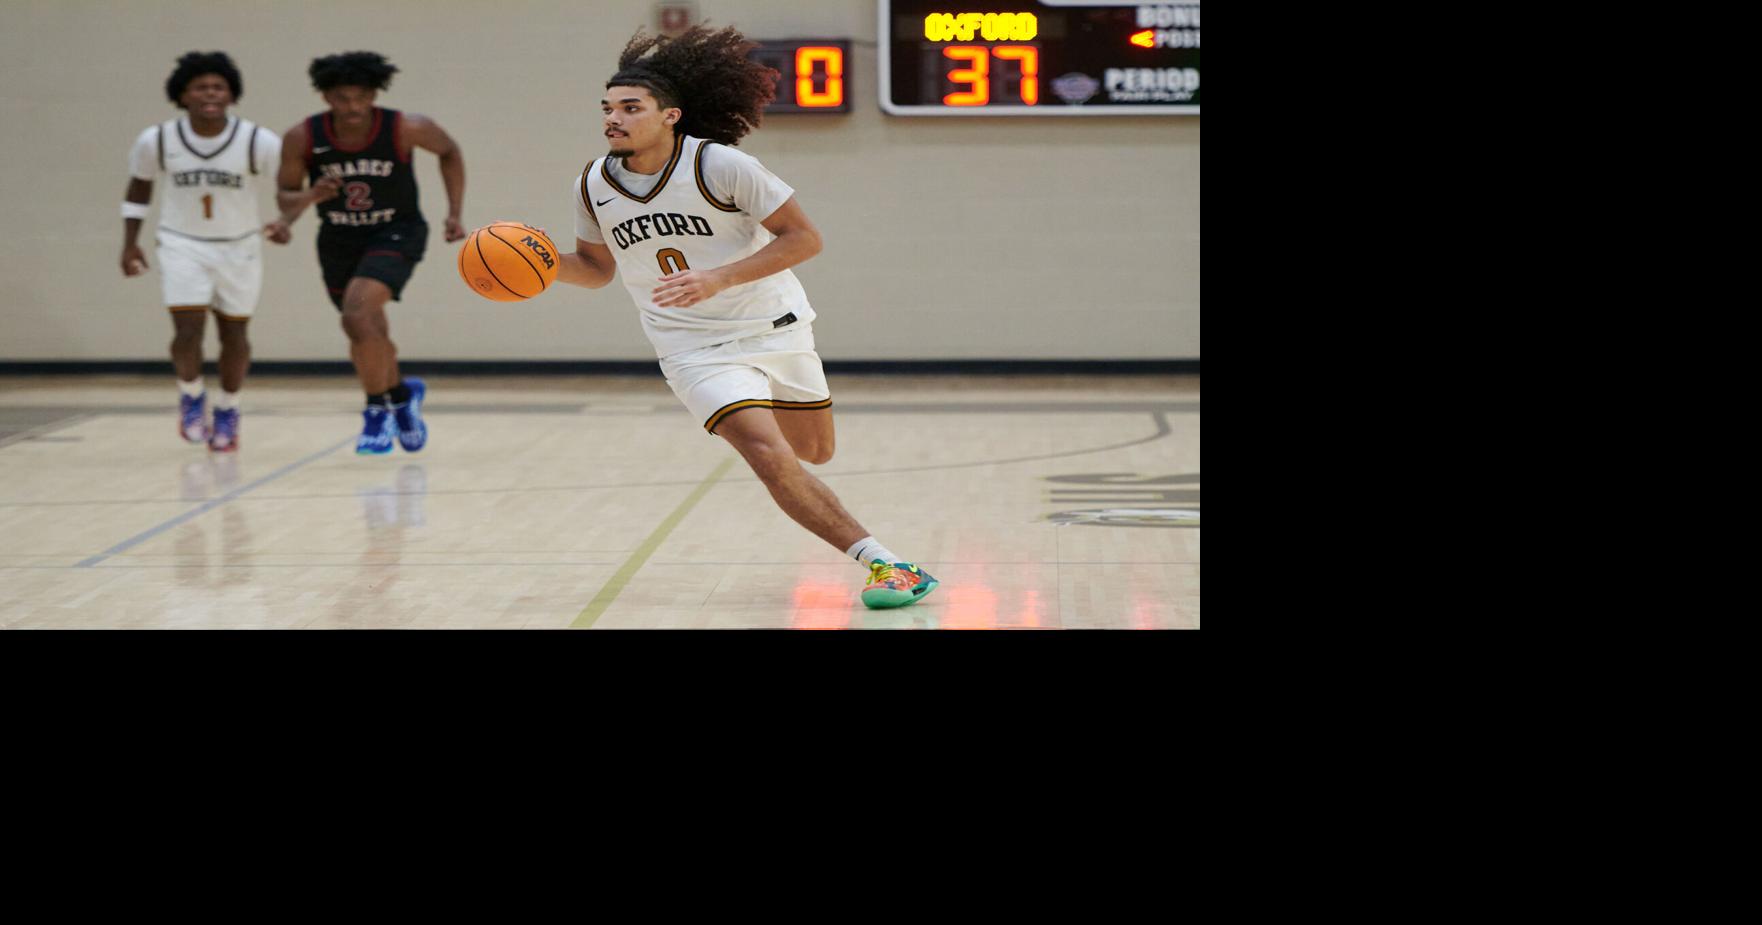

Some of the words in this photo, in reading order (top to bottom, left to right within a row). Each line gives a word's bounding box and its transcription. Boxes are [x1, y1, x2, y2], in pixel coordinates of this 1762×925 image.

[925, 13, 1037, 41] OXFORD
[795, 46, 843, 107] 0
[943, 46, 1038, 106] 37
[1104, 67, 1200, 91] PERIOD
[201, 193, 213, 219] 1
[344, 182, 374, 210] 2
[611, 213, 714, 250] OXFORD
[520, 235, 555, 270] NCAA
